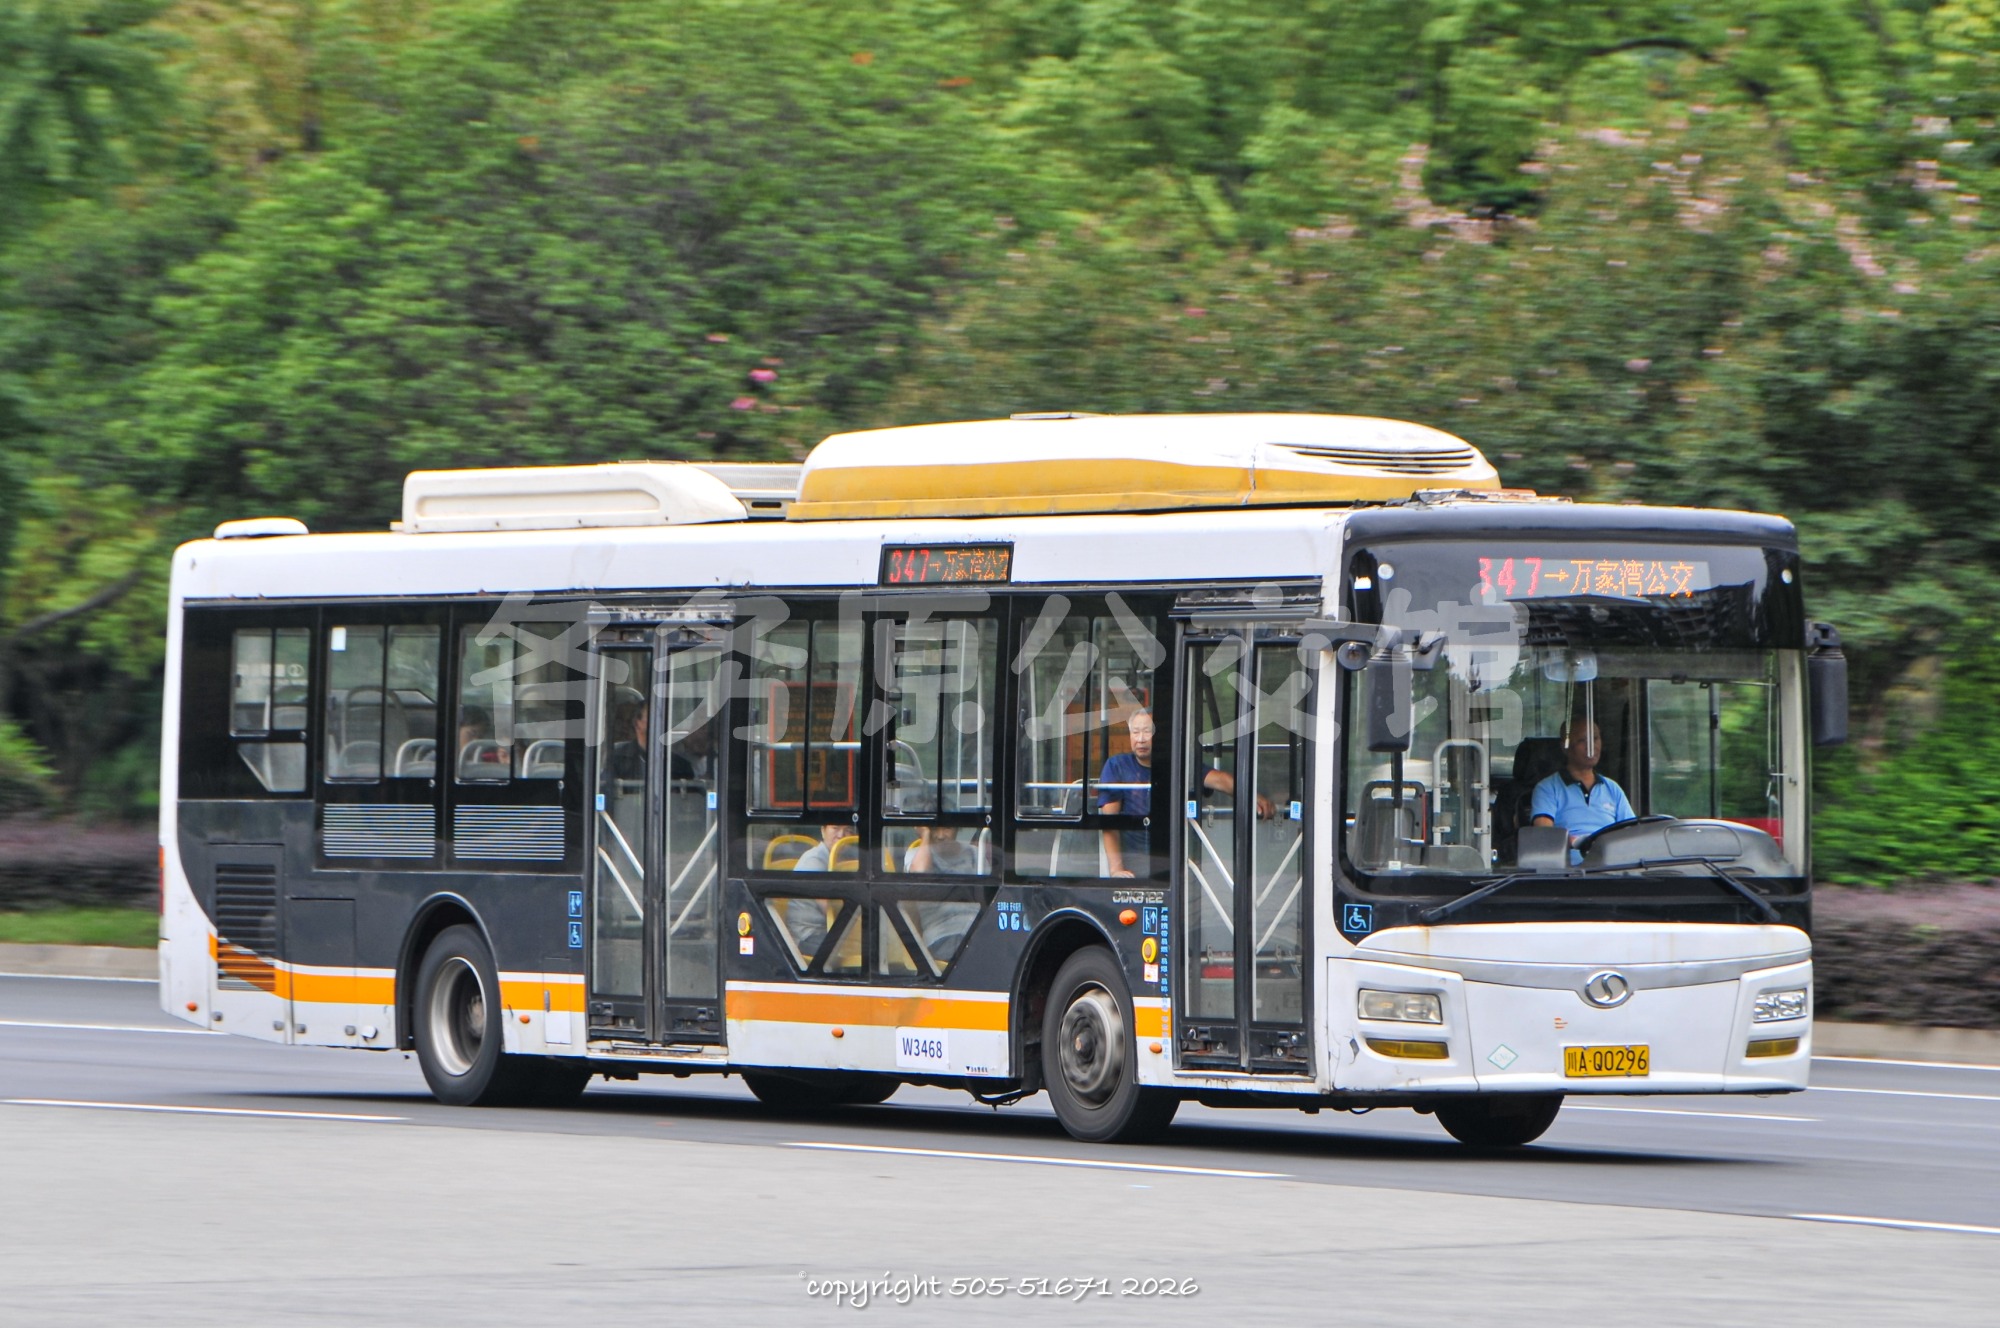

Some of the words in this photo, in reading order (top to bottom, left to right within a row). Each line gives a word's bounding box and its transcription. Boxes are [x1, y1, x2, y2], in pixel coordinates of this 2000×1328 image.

[890, 549, 930, 582] 347
[1478, 557, 1543, 596] 347
[1569, 559, 1695, 598] 万家湾公交
[902, 1037, 943, 1058] W3468
